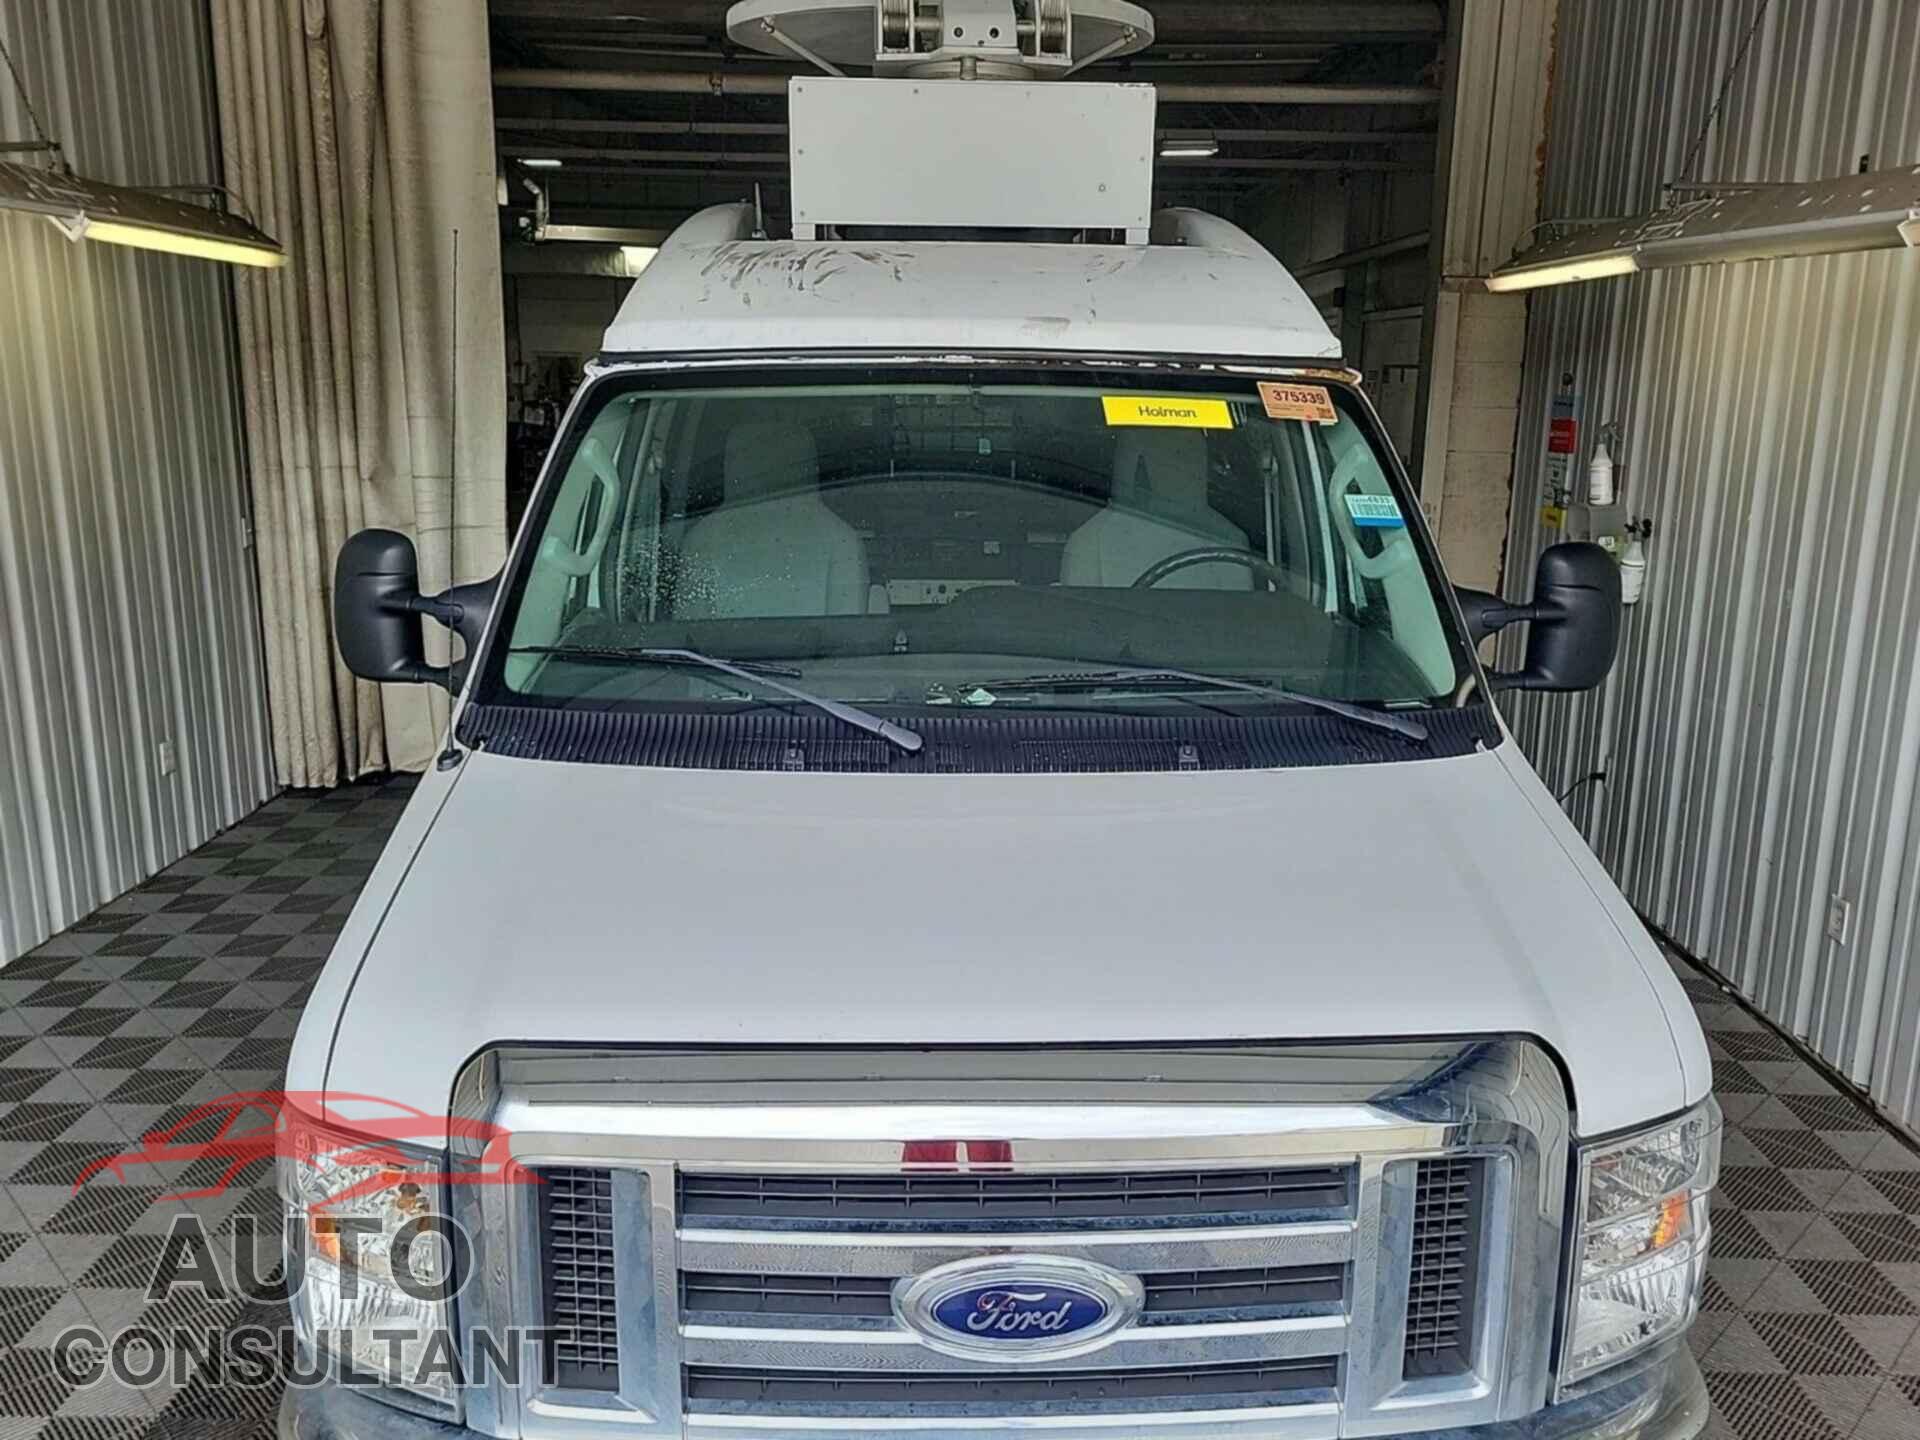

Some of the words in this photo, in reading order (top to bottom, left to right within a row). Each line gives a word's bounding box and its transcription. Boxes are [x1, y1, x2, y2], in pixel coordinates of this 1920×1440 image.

[1272, 389, 1326, 405] 375339
[1137, 406, 1197, 418] Holman
[966, 1290, 1073, 1331] Ford
